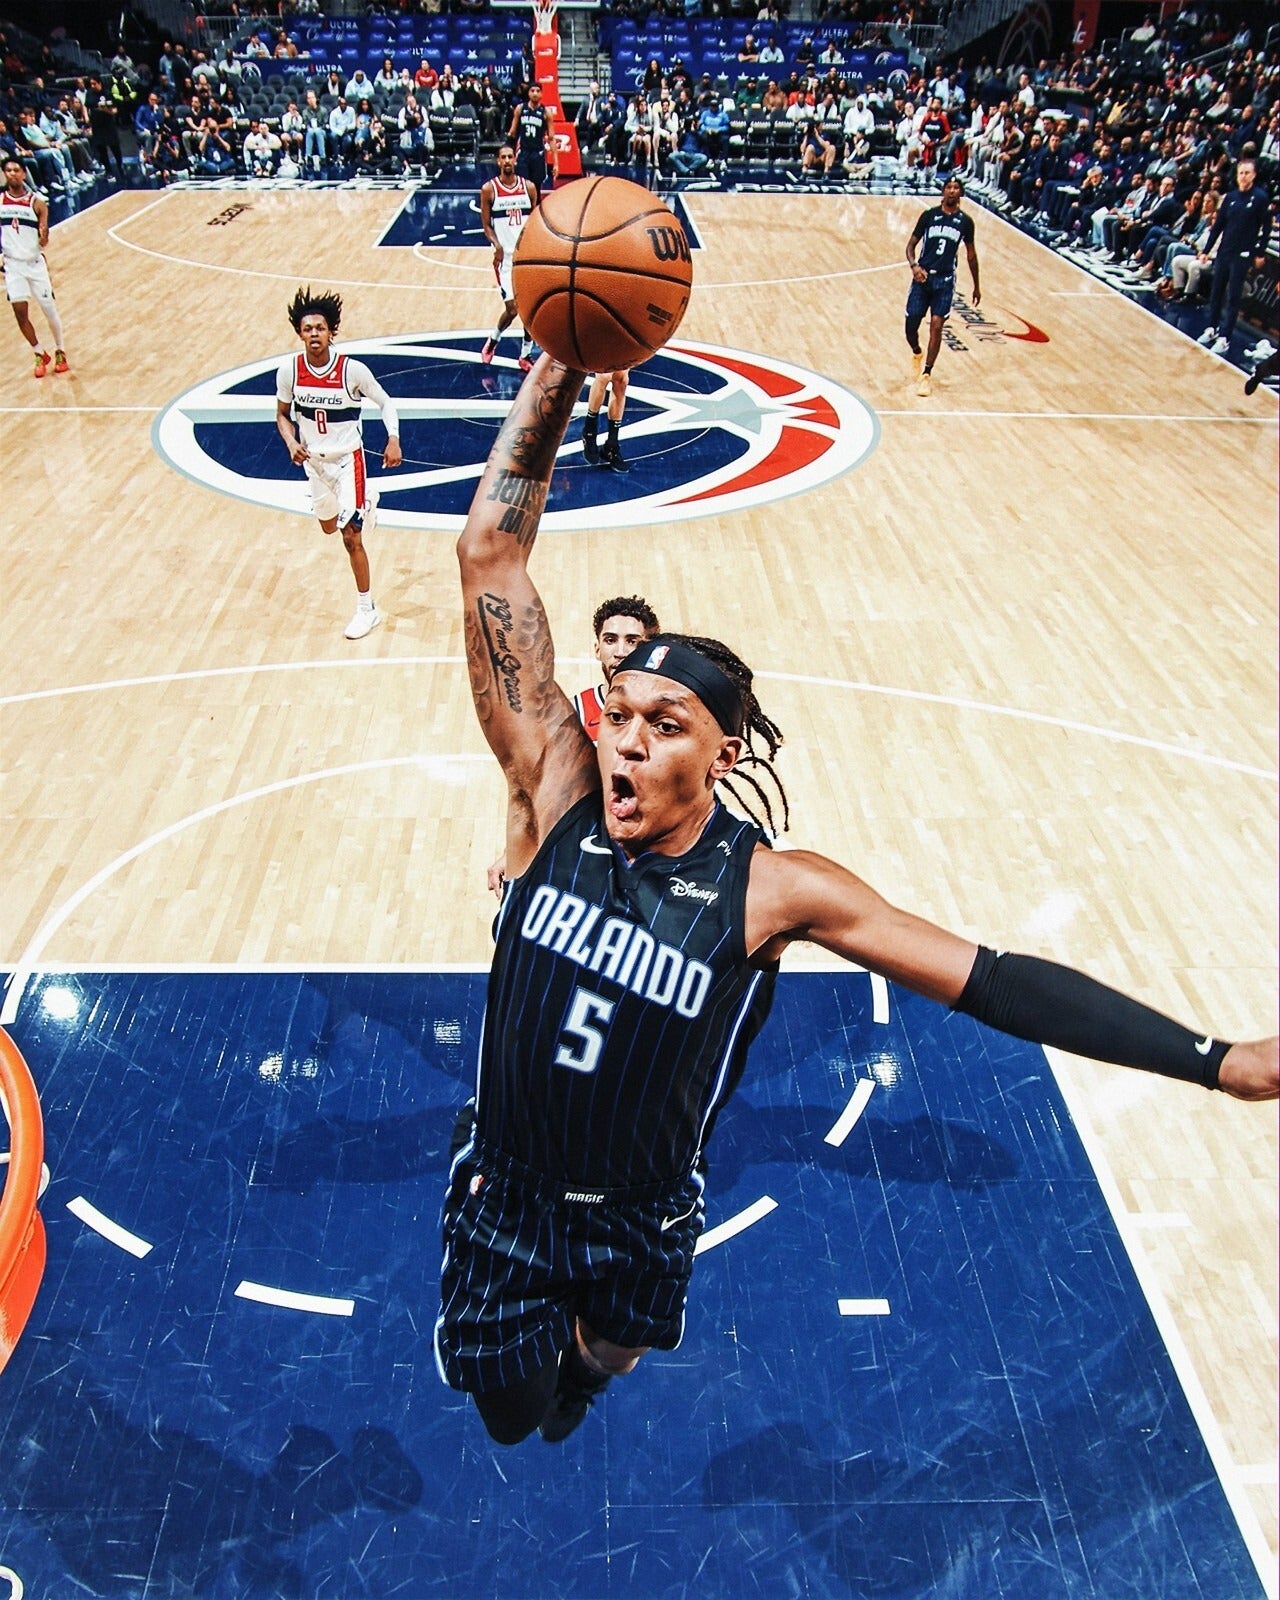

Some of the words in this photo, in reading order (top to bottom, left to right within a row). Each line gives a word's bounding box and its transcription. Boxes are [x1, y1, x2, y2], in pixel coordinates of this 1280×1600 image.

[525, 124, 536, 138] 34
[506, 208, 522, 226] 20
[936, 238, 947, 256] 3
[297, 393, 343, 405] wizards
[315, 408, 328, 435] 8
[716, 840, 731, 857] PW
[521, 884, 714, 1020] ORLANDO
[553, 984, 617, 1074] 5
[565, 1191, 604, 1204] MAGIC
